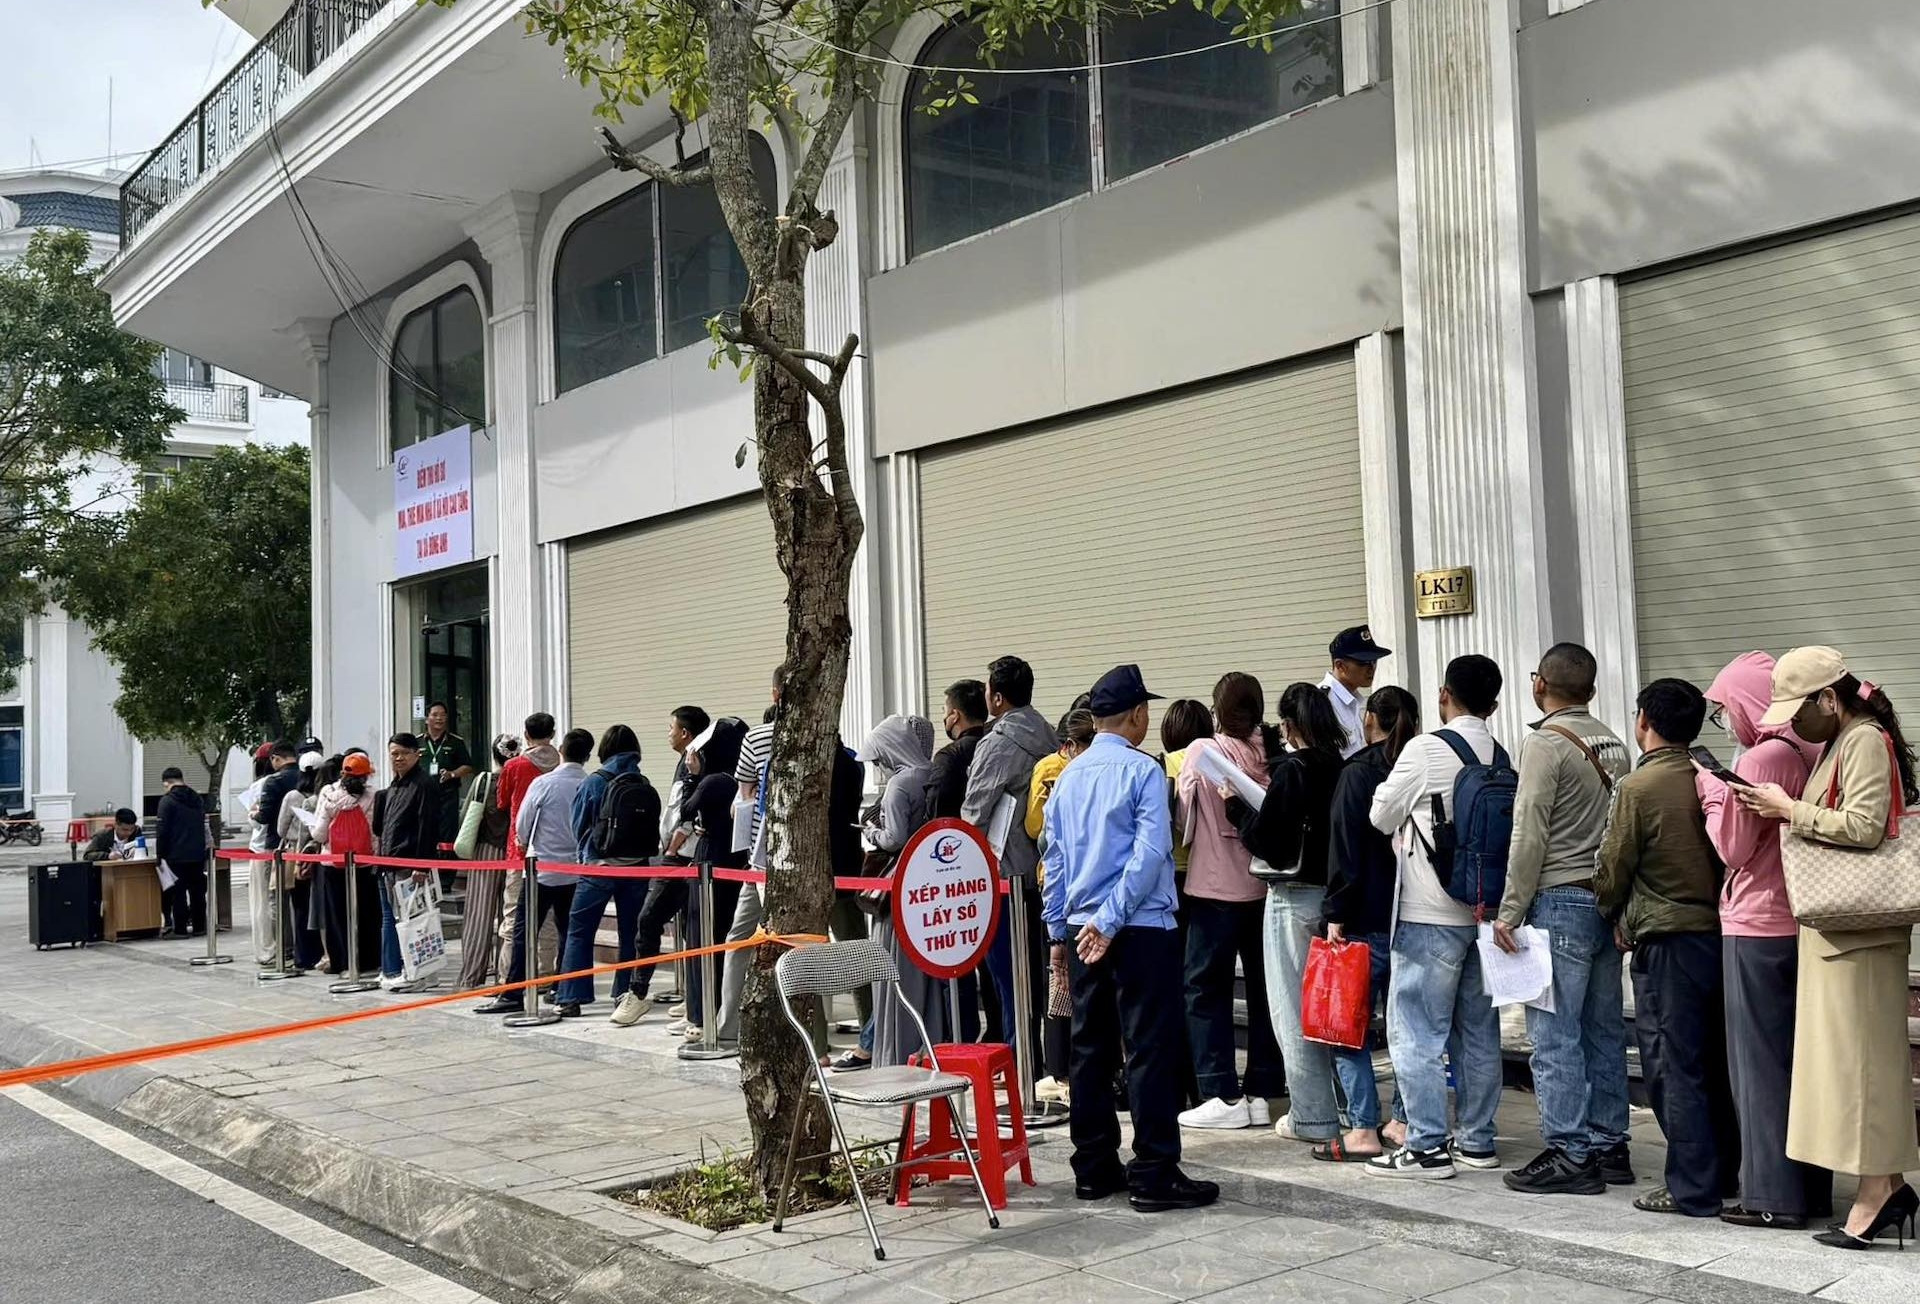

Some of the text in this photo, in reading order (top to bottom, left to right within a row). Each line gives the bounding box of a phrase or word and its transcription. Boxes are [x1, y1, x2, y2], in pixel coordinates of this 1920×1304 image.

[1421, 577, 1464, 596] LK17
[908, 878, 987, 905] XẾP HÀNG
[923, 899, 977, 927] LẤY SỐ
[924, 927, 979, 952] THỨ TỰ
